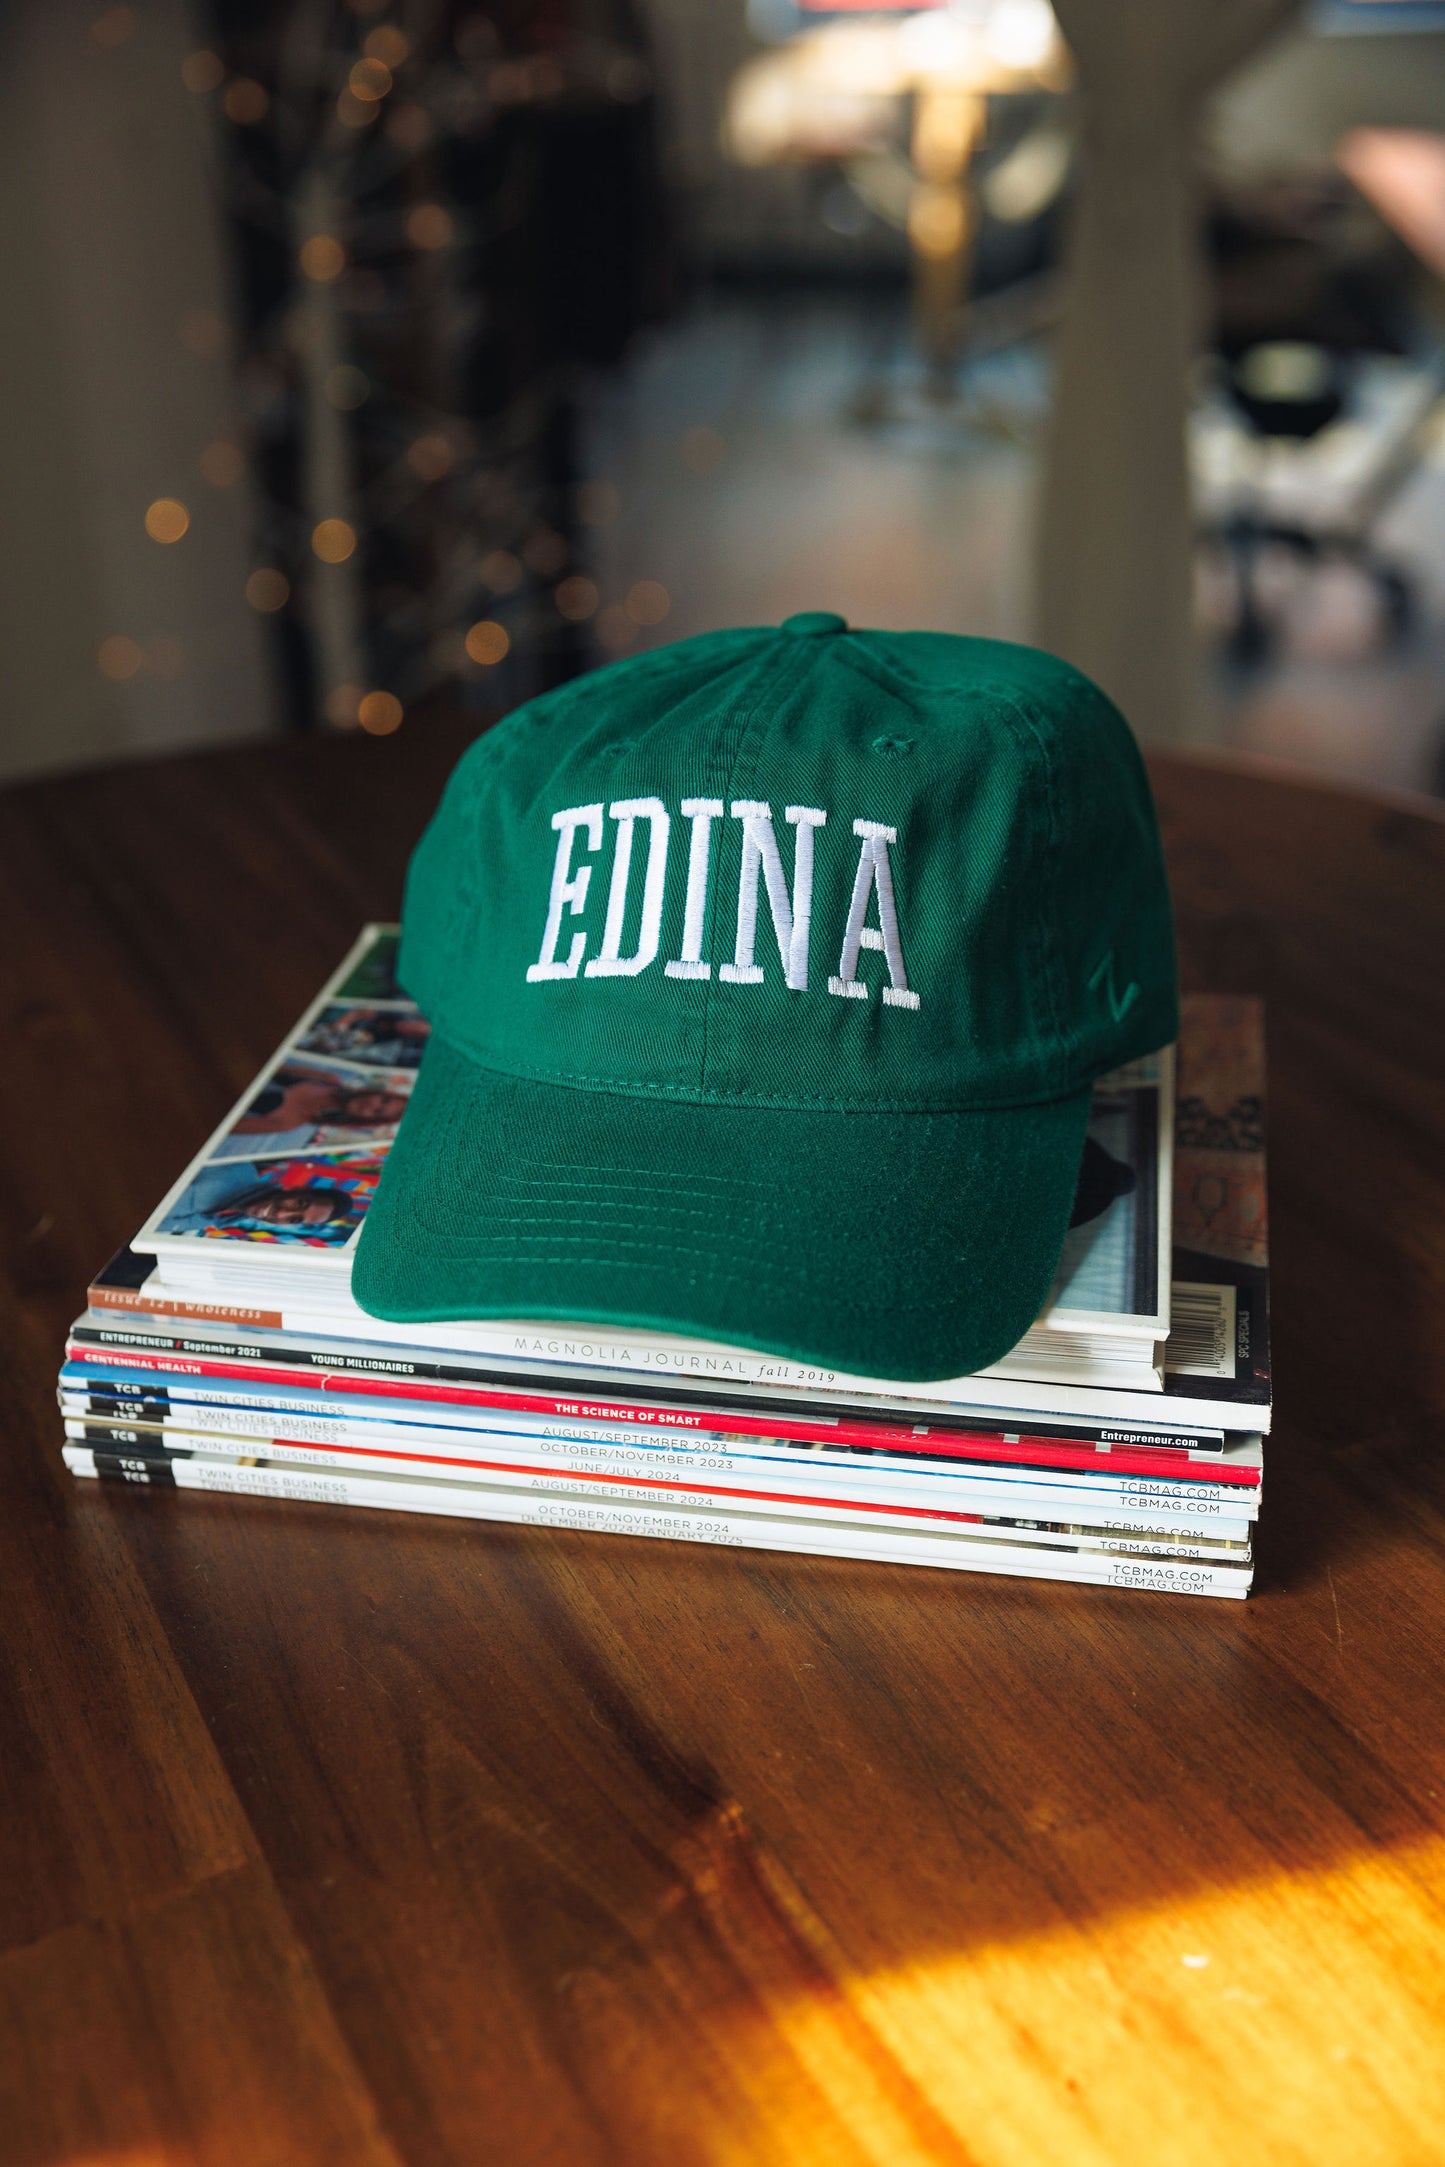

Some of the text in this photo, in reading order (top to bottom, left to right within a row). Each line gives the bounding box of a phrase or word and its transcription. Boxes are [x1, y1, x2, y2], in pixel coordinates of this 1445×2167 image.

[526, 796, 920, 1010] EDINA
[100, 1331, 174, 1348] ENTREPRENEUR
[183, 1340, 235, 1355] September
[237, 1347, 261, 1358] 2021
[1238, 1344, 1249, 1358] SPC
[84, 1353, 201, 1374] CENTENNIAL HEALTH
[311, 1354, 415, 1373] YOUNG MILLIONAIRES
[514, 1337, 835, 1383] MAGNOLIA JOURNAL fall 2019
[114, 1383, 141, 1394] TCB
[116, 1401, 144, 1413] TCB
[194, 1392, 345, 1415] TWIN CITIES BUSINESS
[196, 1410, 347, 1432] TWIN CITIES BUSINESS
[555, 1403, 702, 1426] THE SCIENCE OF SMART
[110, 1429, 137, 1442] TCB
[273, 1425, 338, 1443] BUSINESS
[543, 1426, 728, 1453] AUGUST/SEPTEMBER 2023
[1101, 1430, 1198, 1447] Entrepreneur.com
[188, 1439, 337, 1464] TWIN CITIES BUSINESS
[540, 1442, 733, 1469] OCTOBER/NOVEMBER 2023
[119, 1459, 146, 1471] TCB
[567, 1461, 680, 1481] JUNE/JULY 2024
[122, 1471, 150, 1483] TCB
[198, 1468, 347, 1492] TWIN CITIES BUSINESS
[531, 1479, 713, 1506] AUGUST/SEPTEMBER 2024
[1119, 1481, 1220, 1500] TCBMAG.COM
[1119, 1496, 1220, 1513] TCBMAG.COM
[538, 1505, 729, 1533] OCTOBER/NOVEMBER 2024
[521, 1514, 743, 1545] DECEMBER 2024/JANUARY 2025
[1104, 1520, 1204, 1538] TCBMAG.COM
[1100, 1540, 1199, 1557] TCBMAG.COM
[1113, 1565, 1213, 1582] TCBMAG.COM
[1106, 1575, 1204, 1592] TCBMAG.COM
